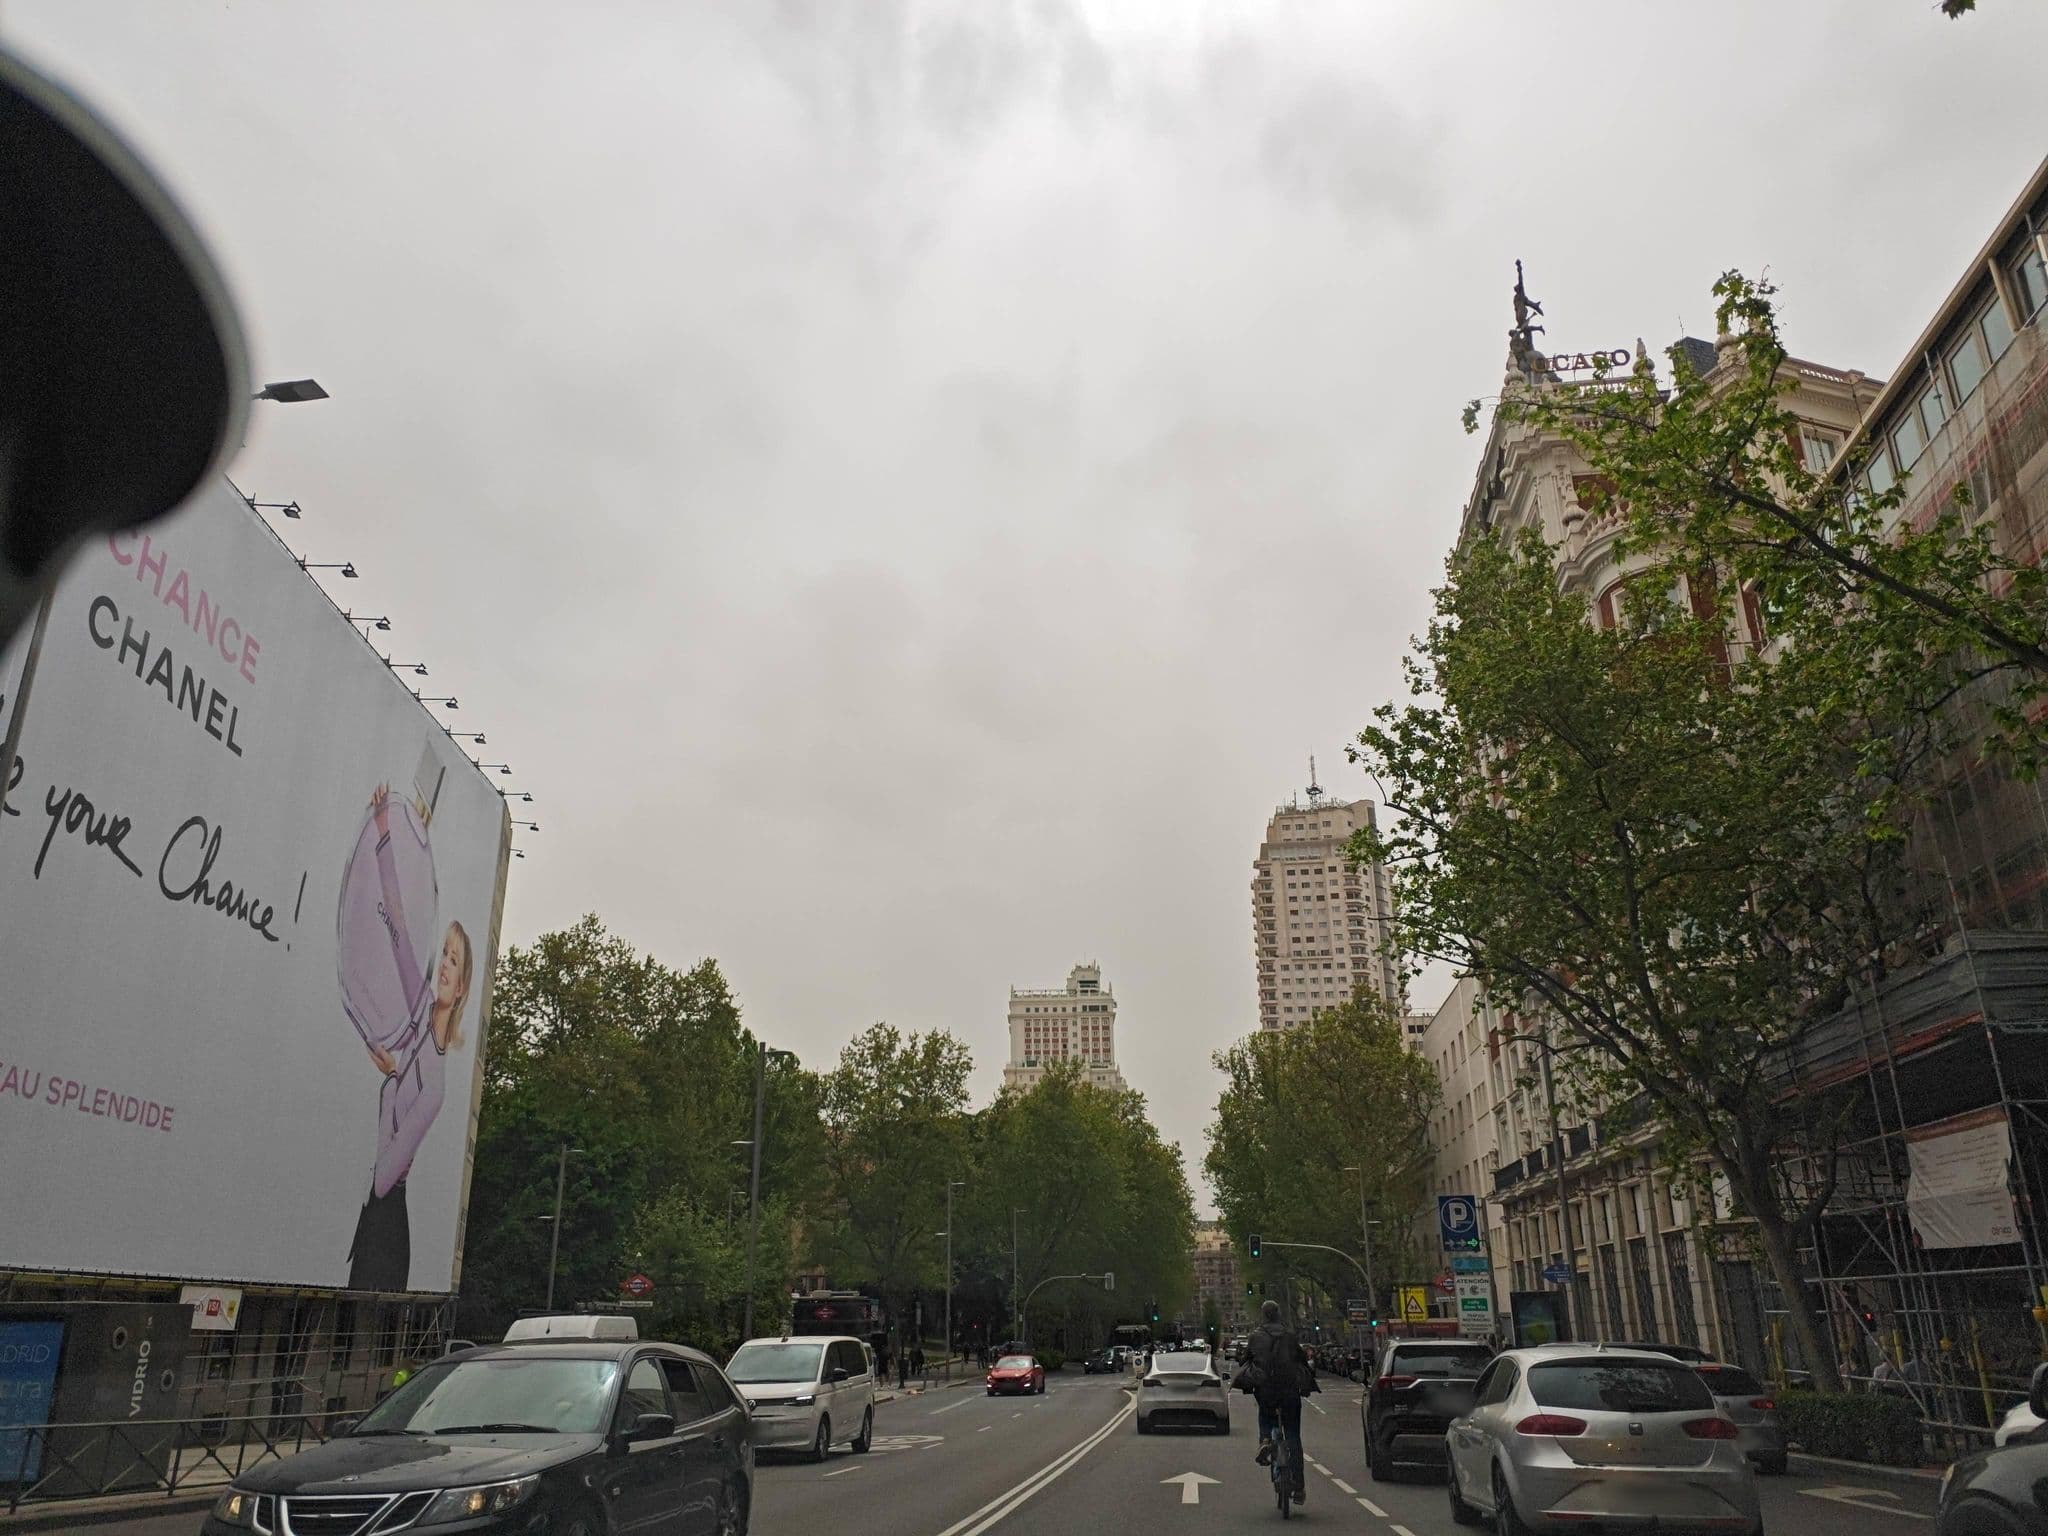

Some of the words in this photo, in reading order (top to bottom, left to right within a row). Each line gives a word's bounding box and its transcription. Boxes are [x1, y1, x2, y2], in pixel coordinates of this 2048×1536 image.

[108, 529, 261, 685] CHANCE
[88, 595, 243, 758] CHANEL
[0, 1062, 41, 1099] AU
[46, 1076, 175, 1132] SPLENDIDE
[1449, 1203, 1467, 1228] P
[129, 1340, 151, 1417] VIDRIO
